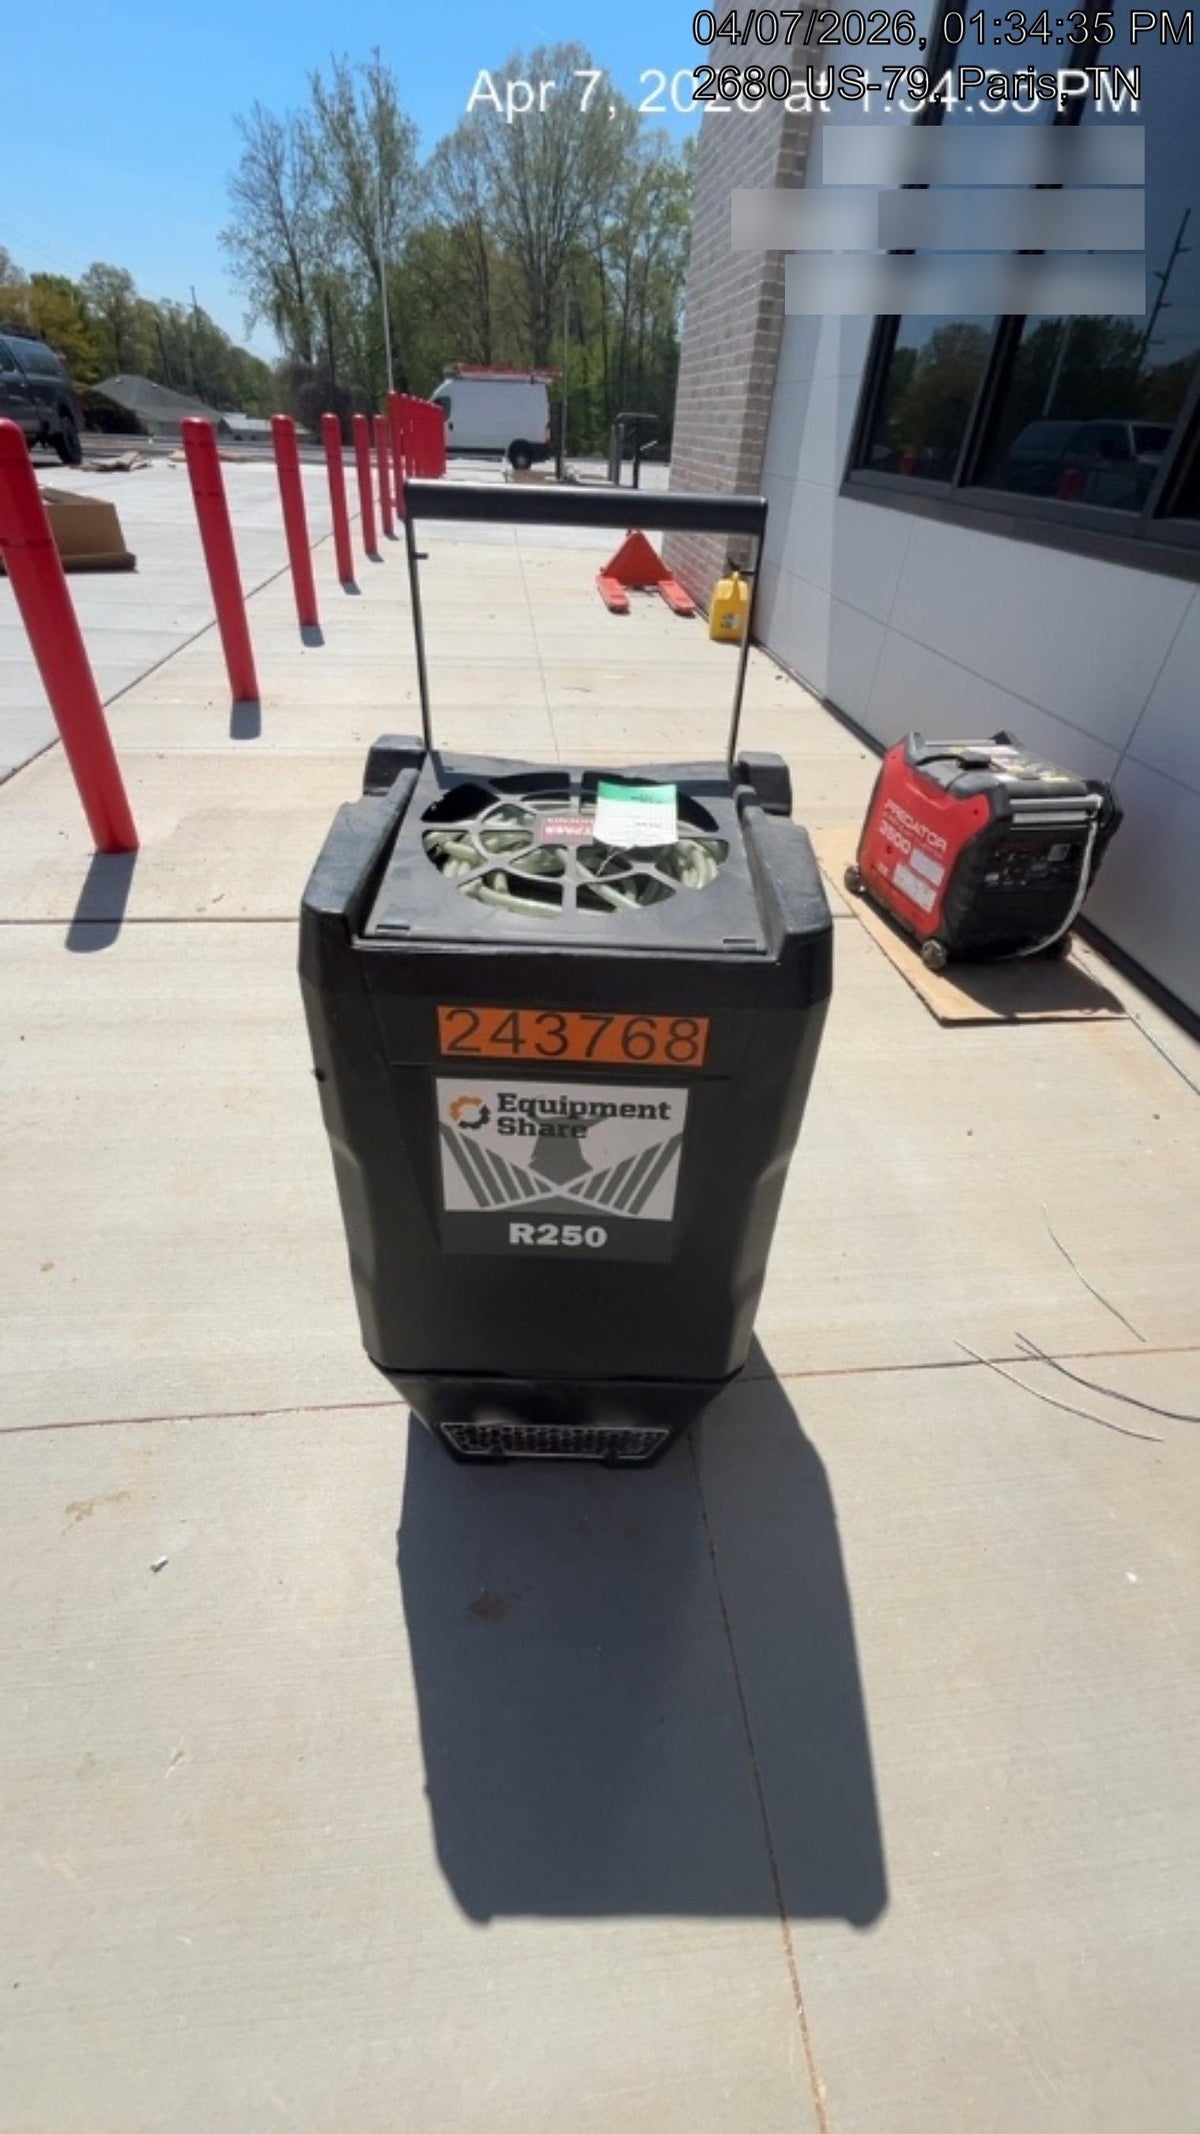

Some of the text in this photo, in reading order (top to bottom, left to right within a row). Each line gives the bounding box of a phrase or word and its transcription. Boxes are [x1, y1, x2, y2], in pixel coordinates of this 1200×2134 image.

[884, 798, 947, 853] PREDATOR
[445, 1009, 699, 1063] 243768
[497, 1092, 671, 1121] Equipment
[497, 1116, 588, 1139] Share
[509, 1222, 608, 1248] R250
